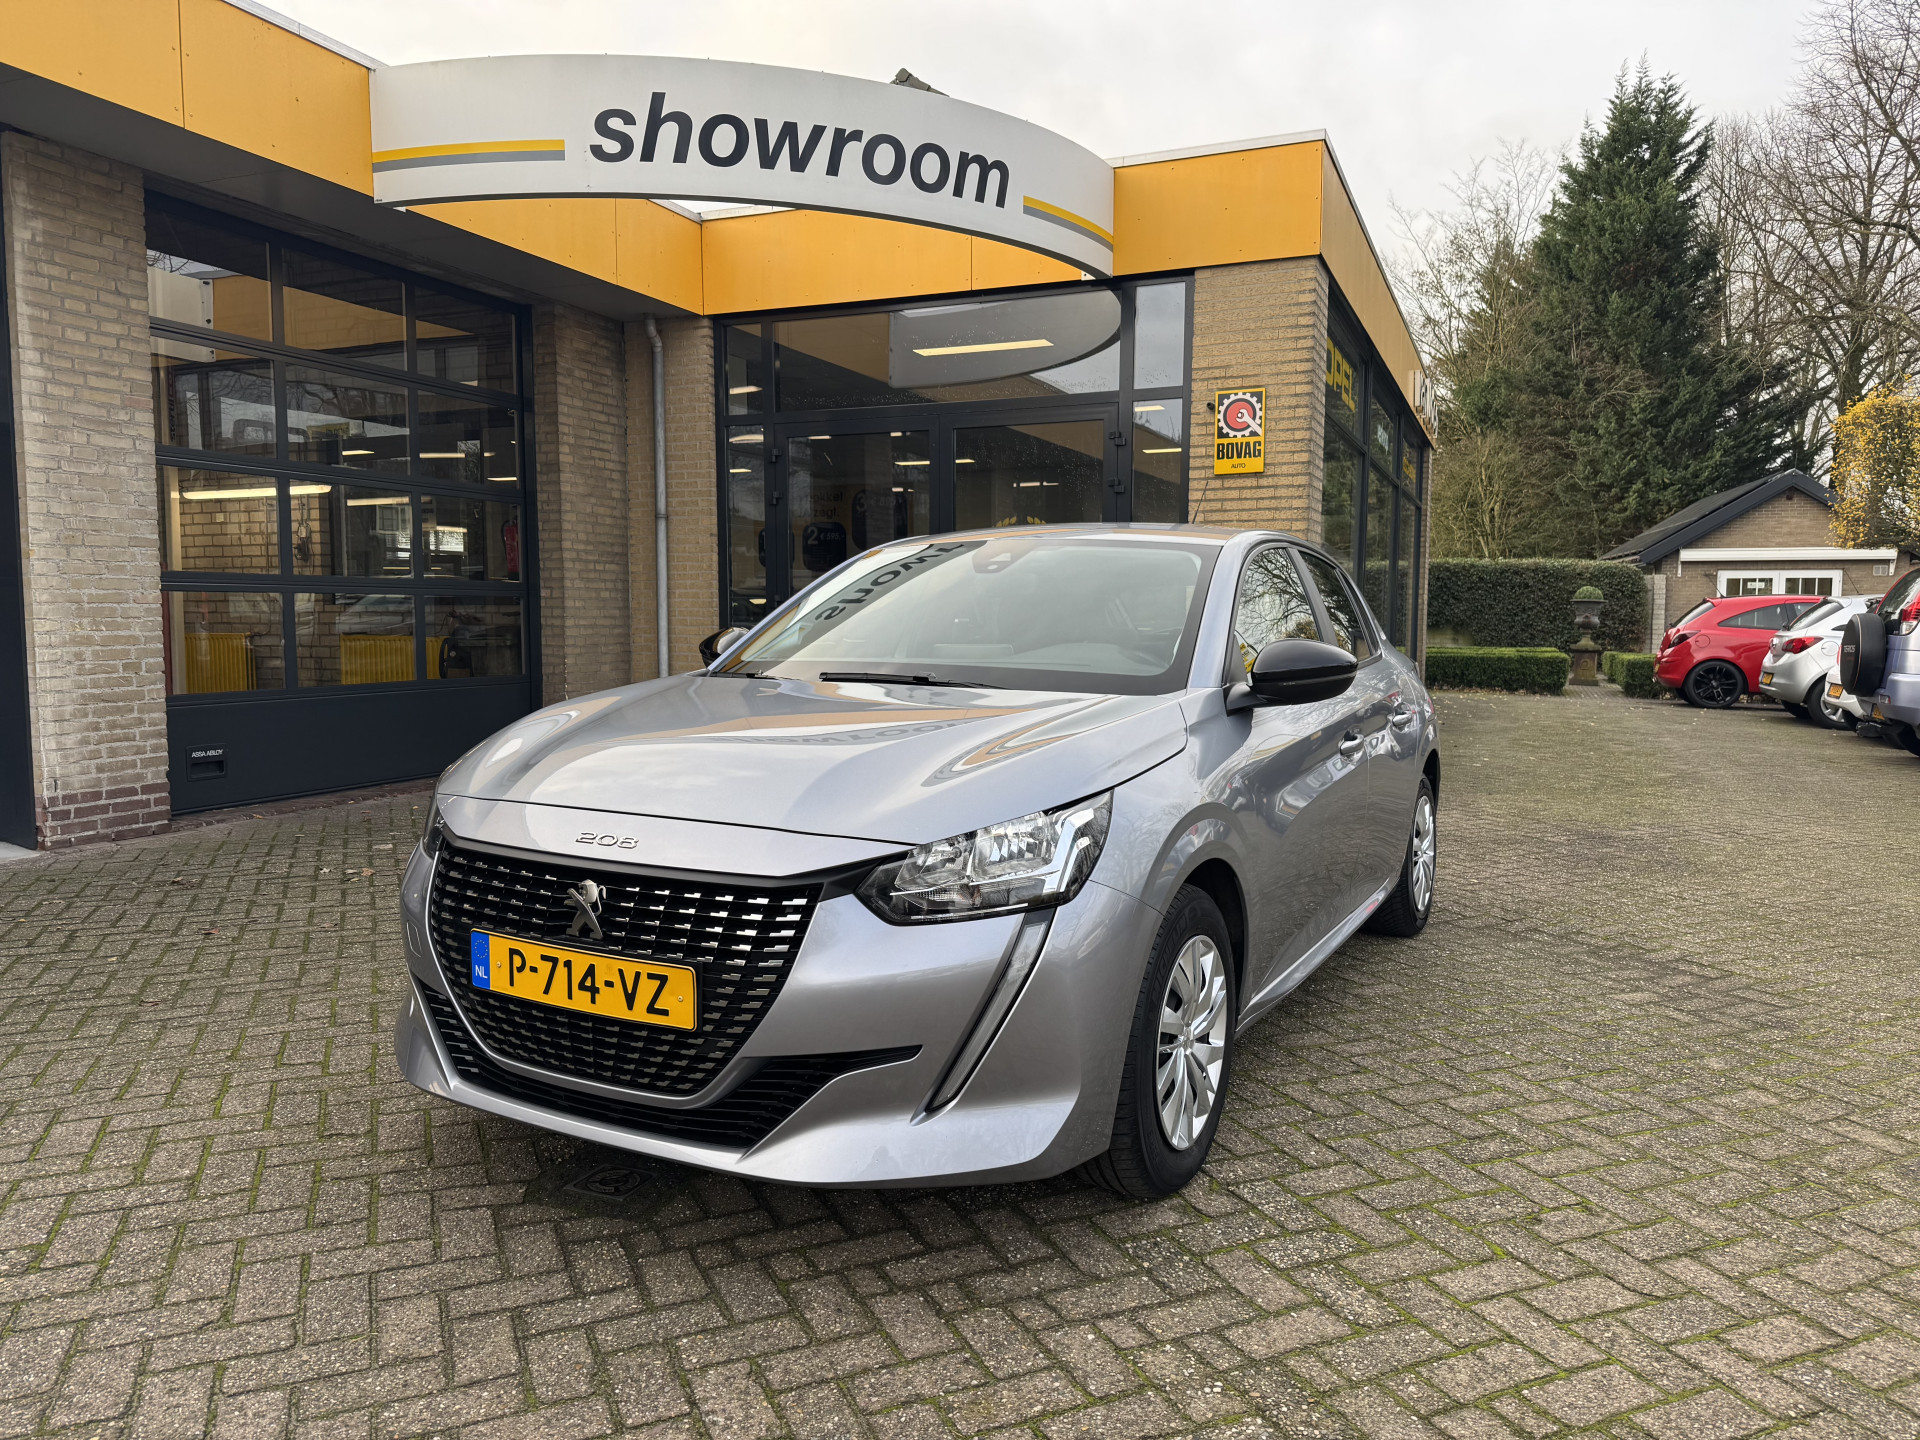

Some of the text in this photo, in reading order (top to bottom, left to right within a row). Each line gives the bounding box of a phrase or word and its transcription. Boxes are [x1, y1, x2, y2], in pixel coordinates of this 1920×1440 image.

[588, 90, 1011, 209] showroom
[1326, 336, 1356, 413] OPEL
[1216, 440, 1262, 460] BOVAG
[807, 526, 818, 545] 2
[575, 831, 640, 849] 208
[475, 965, 488, 979] NL
[508, 947, 670, 1017] P-714-VZ
